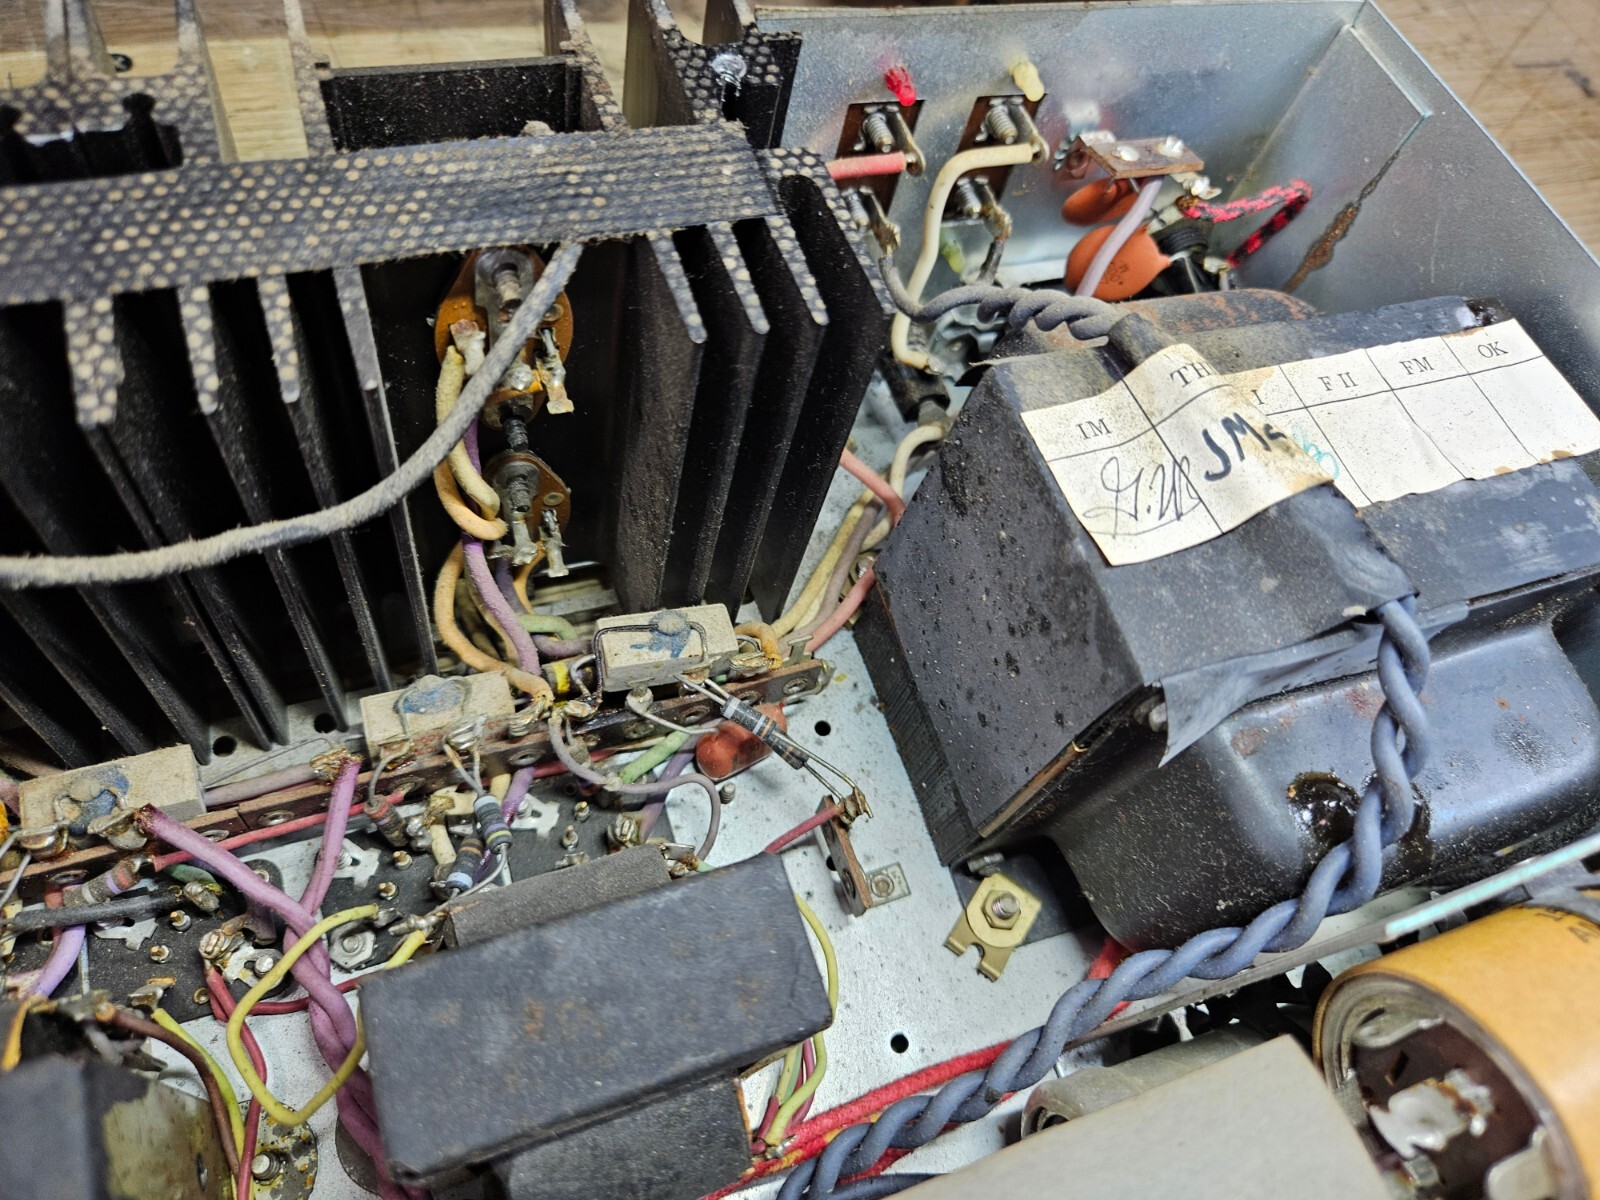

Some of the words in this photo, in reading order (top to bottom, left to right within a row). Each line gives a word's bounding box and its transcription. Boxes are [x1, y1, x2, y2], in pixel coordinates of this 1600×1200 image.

[1477, 341, 1509, 359] OK
[1399, 356, 1435, 375] FM
[1076, 418, 1112, 441] IM
